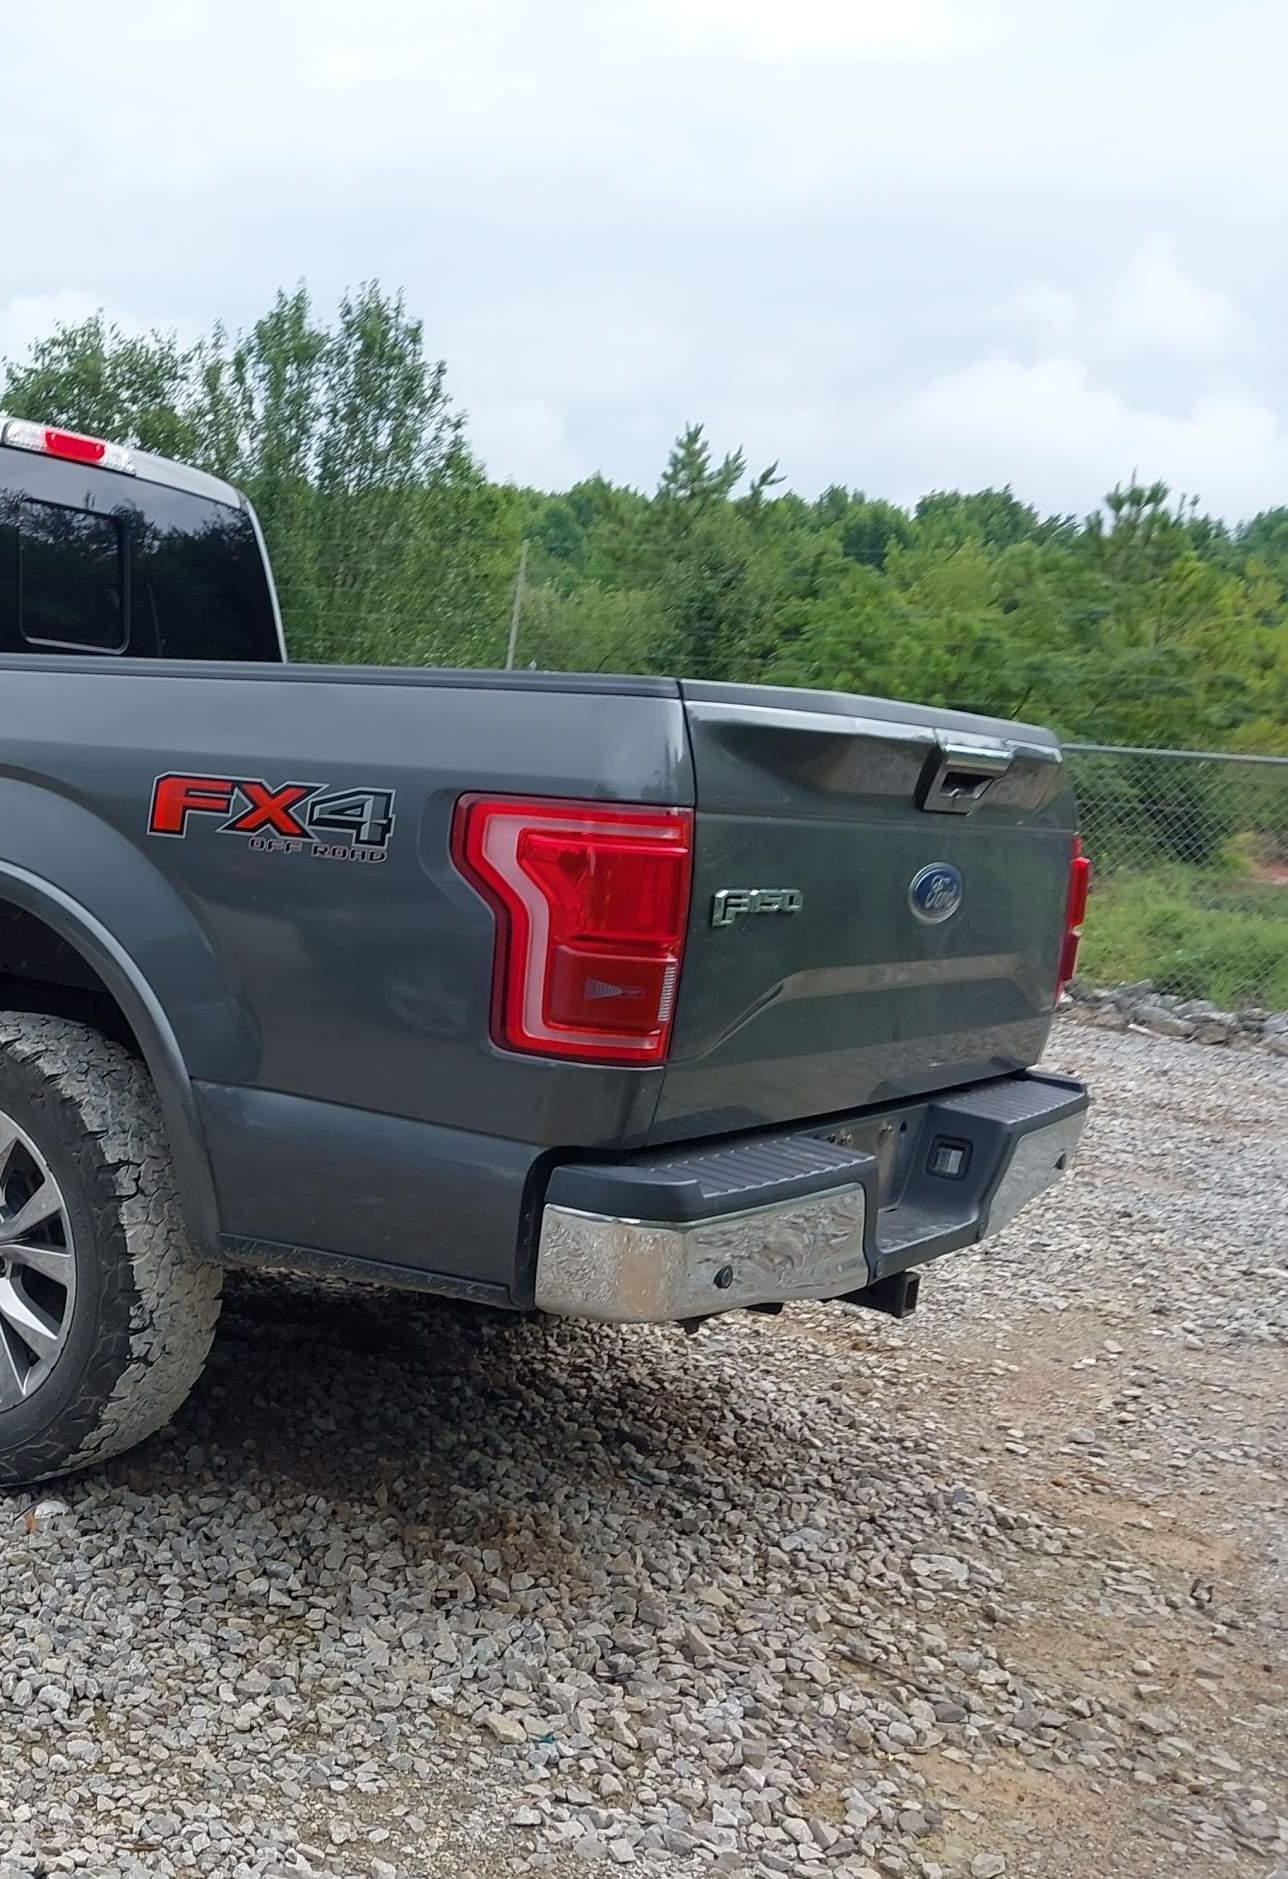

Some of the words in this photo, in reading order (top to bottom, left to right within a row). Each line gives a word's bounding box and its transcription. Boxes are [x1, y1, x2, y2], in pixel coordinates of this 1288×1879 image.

[147, 770, 396, 848] FX4
[248, 836, 303, 854] OFF
[311, 843, 388, 864] ROAD
